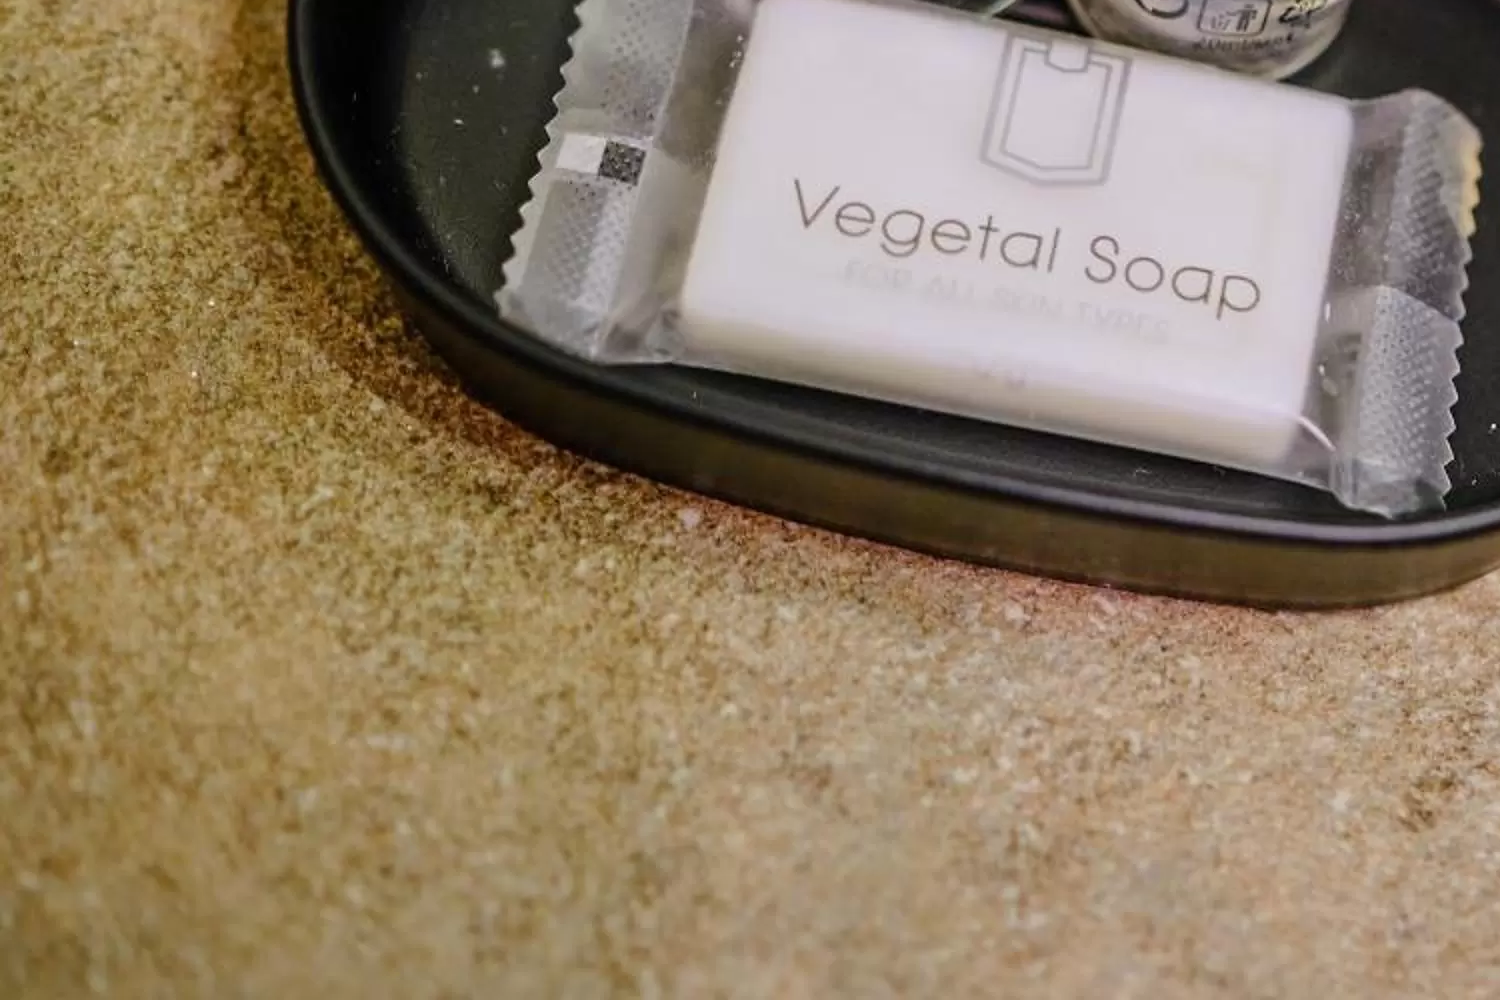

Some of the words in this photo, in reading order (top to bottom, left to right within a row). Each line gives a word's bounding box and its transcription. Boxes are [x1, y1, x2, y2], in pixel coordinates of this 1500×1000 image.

[794, 178, 1061, 274] Vegetal
[1084, 235, 1261, 321] Soap
[843, 257, 913, 290] FOR
[922, 273, 976, 304] ALL
[1078, 300, 1170, 346] TYPES
